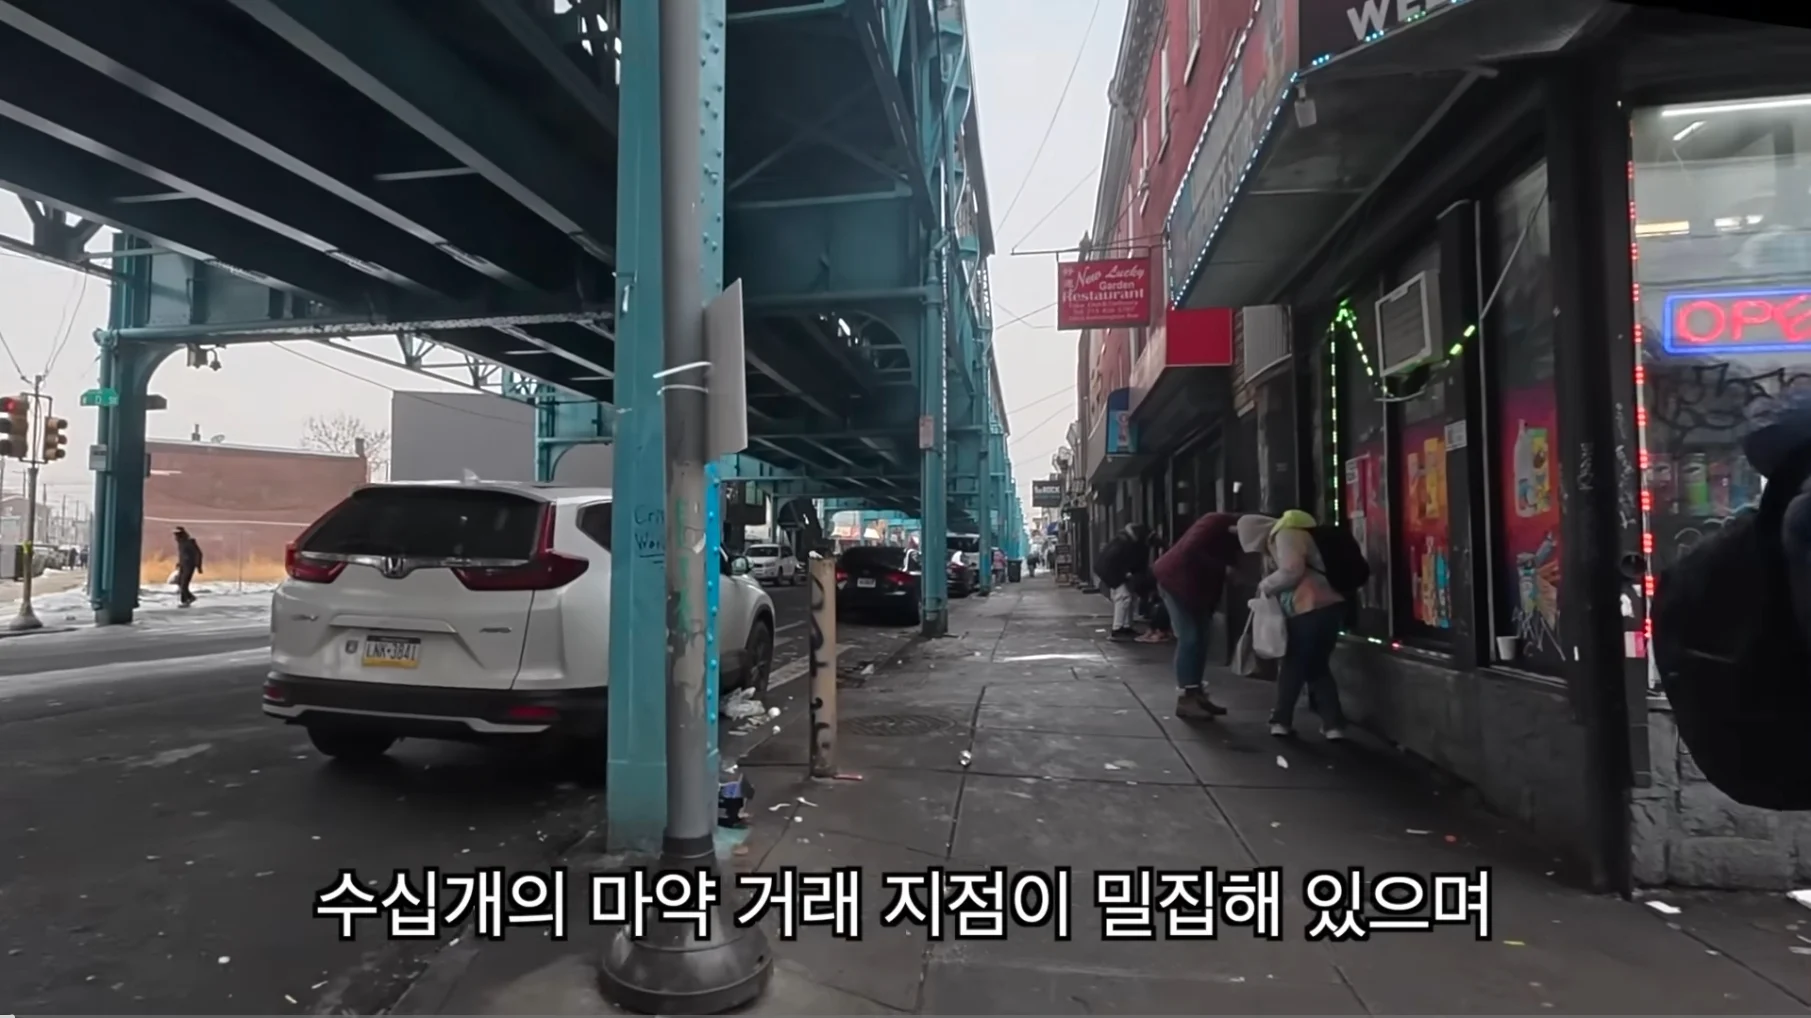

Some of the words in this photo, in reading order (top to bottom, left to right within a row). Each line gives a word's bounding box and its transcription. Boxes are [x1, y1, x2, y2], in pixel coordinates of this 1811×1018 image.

[1347, 0, 1448, 41] WE
[1073, 266, 1101, 291] New
[1105, 265, 1145, 279] Lucky
[1099, 280, 1135, 291] Garden
[1063, 288, 1144, 303] Restaurant
